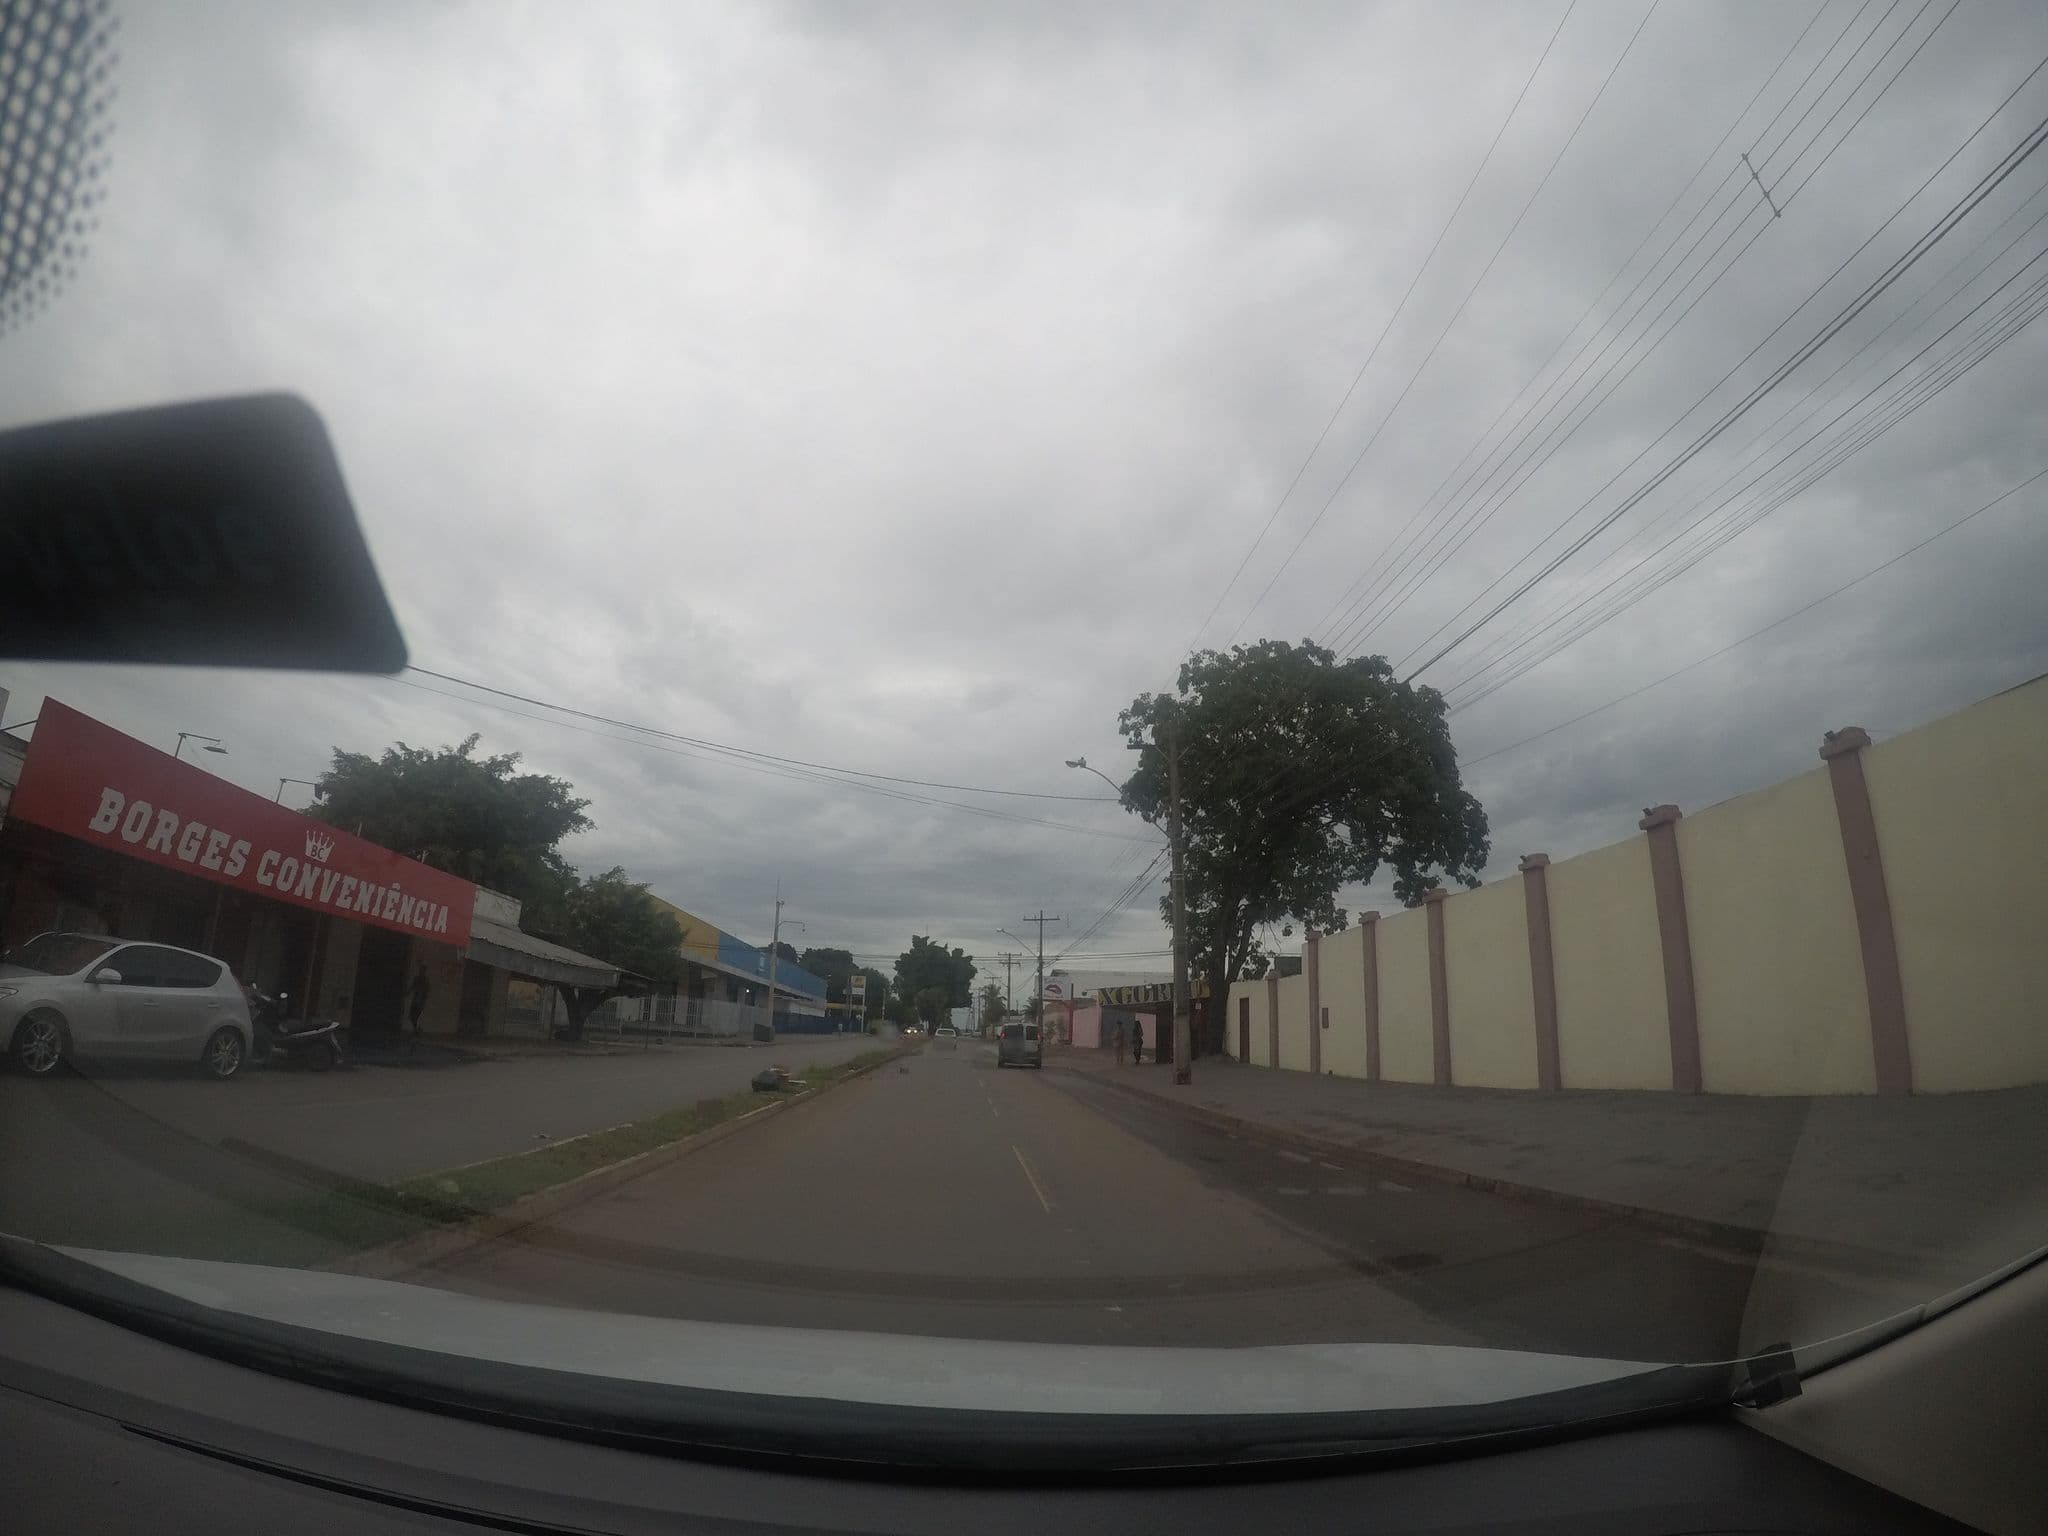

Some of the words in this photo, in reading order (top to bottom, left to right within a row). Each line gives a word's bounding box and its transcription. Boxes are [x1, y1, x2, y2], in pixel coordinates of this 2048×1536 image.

[88, 787, 252, 877] BORGES
[255, 849, 449, 934] CONVENIÊNCIA
[311, 844, 325, 859] BC
